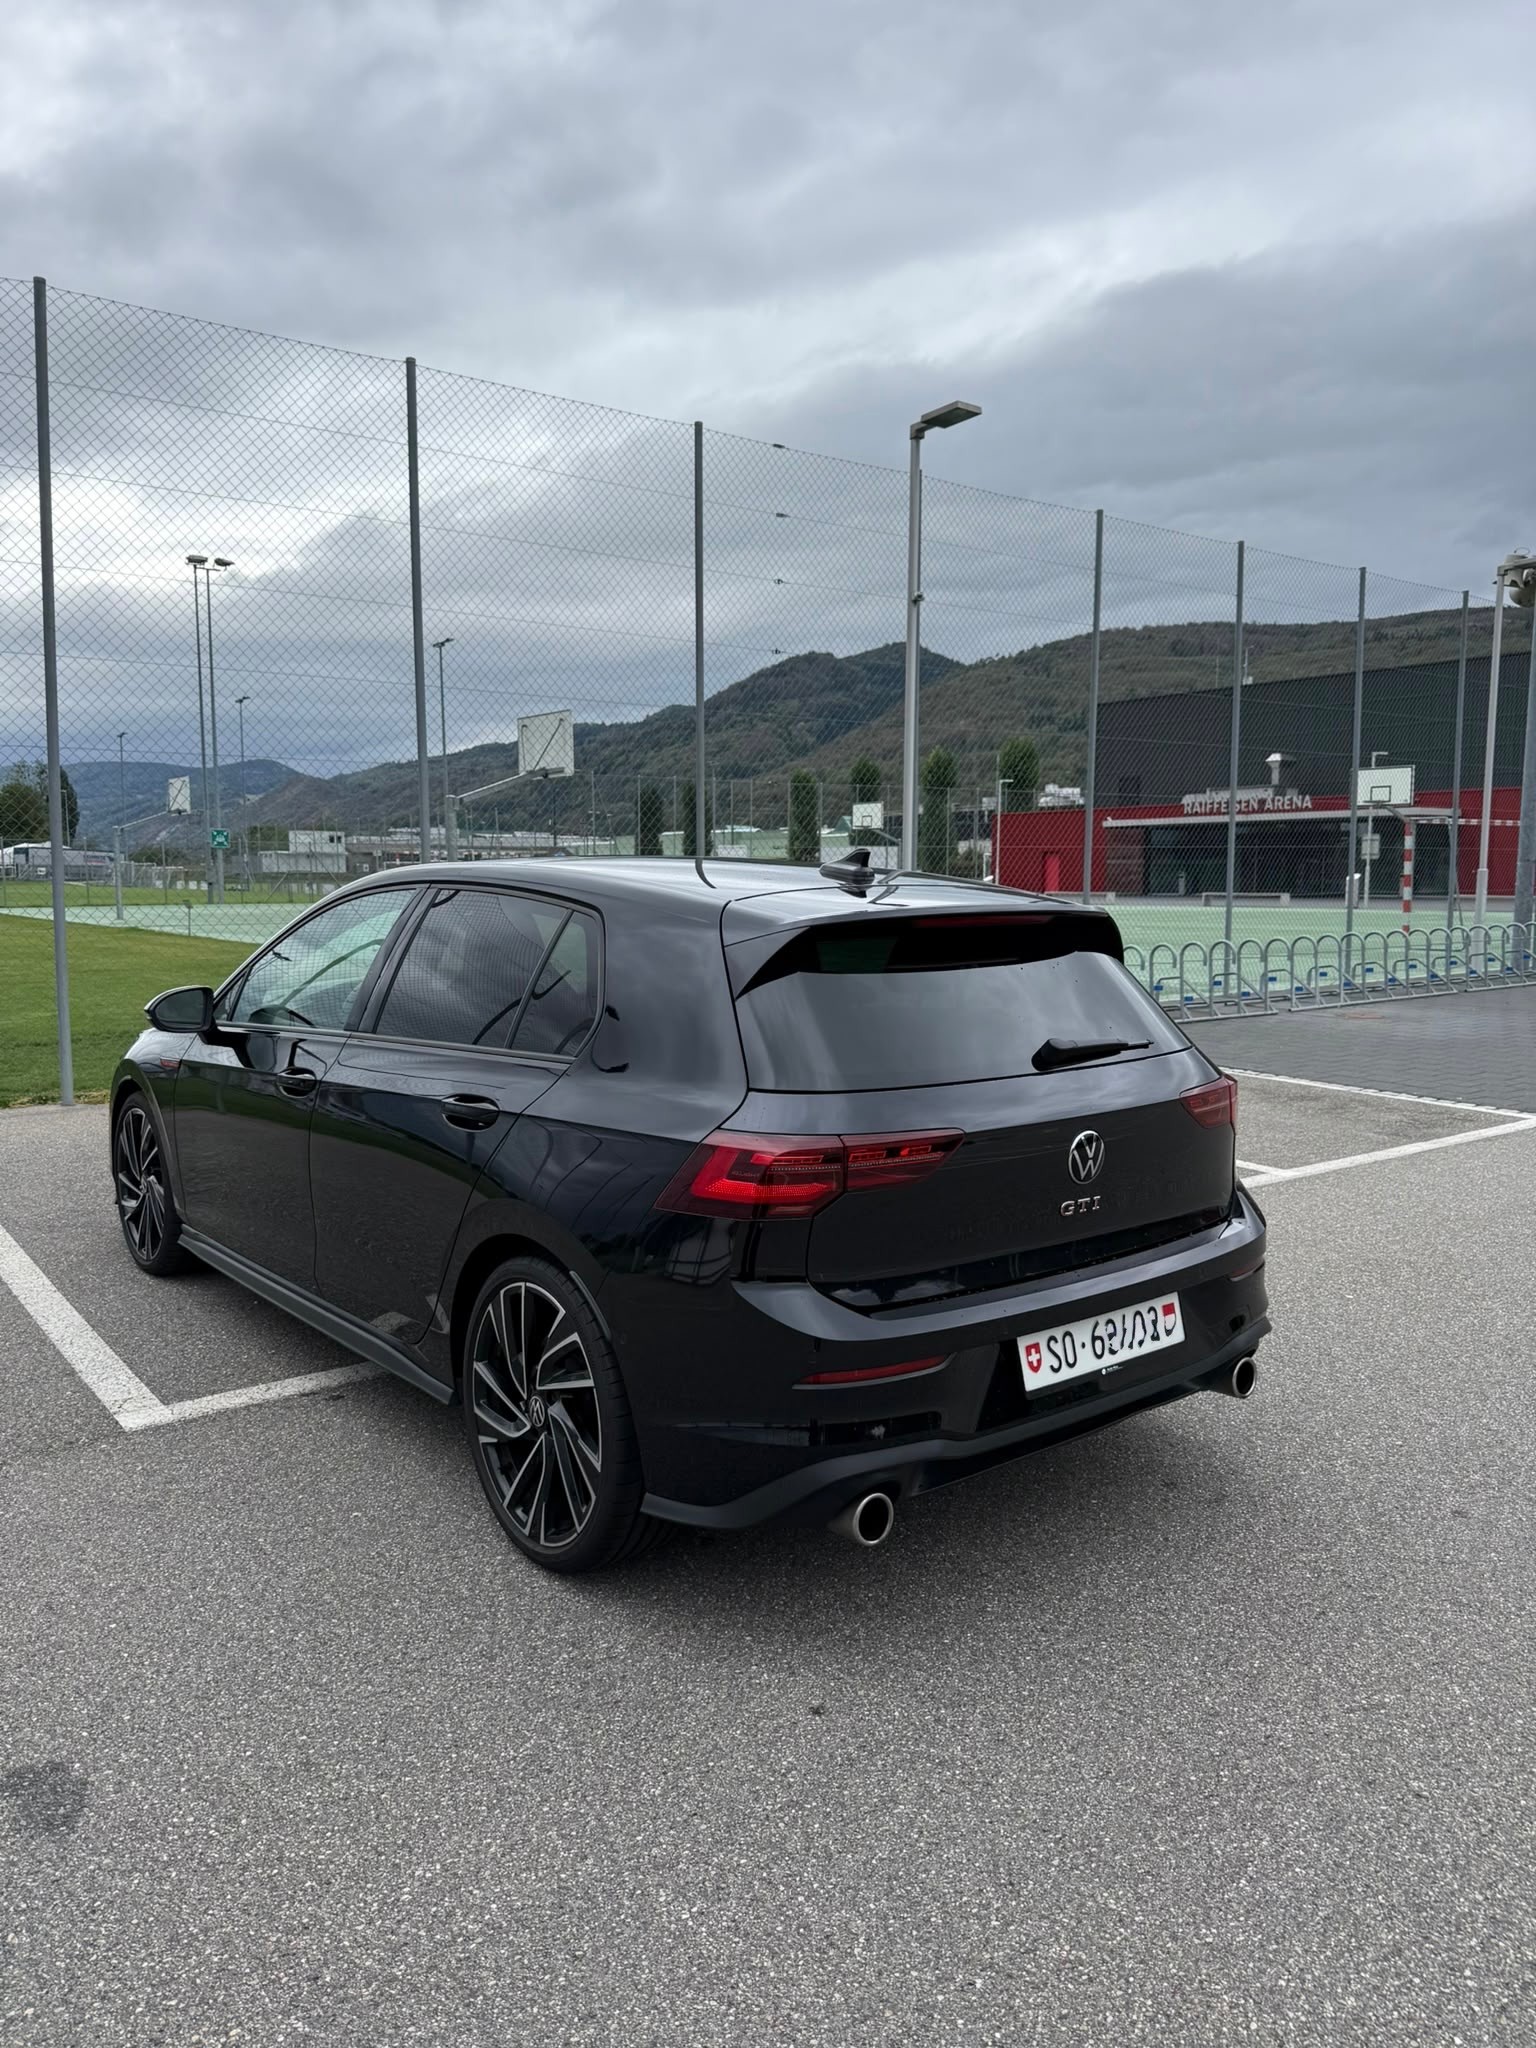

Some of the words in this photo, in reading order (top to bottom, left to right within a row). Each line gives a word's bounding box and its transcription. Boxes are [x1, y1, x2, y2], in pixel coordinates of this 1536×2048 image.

[1183, 796, 1258, 815] RAIFFESEN
[1264, 794, 1312, 811] ARENA
[1061, 1195, 1101, 1216] GTI
